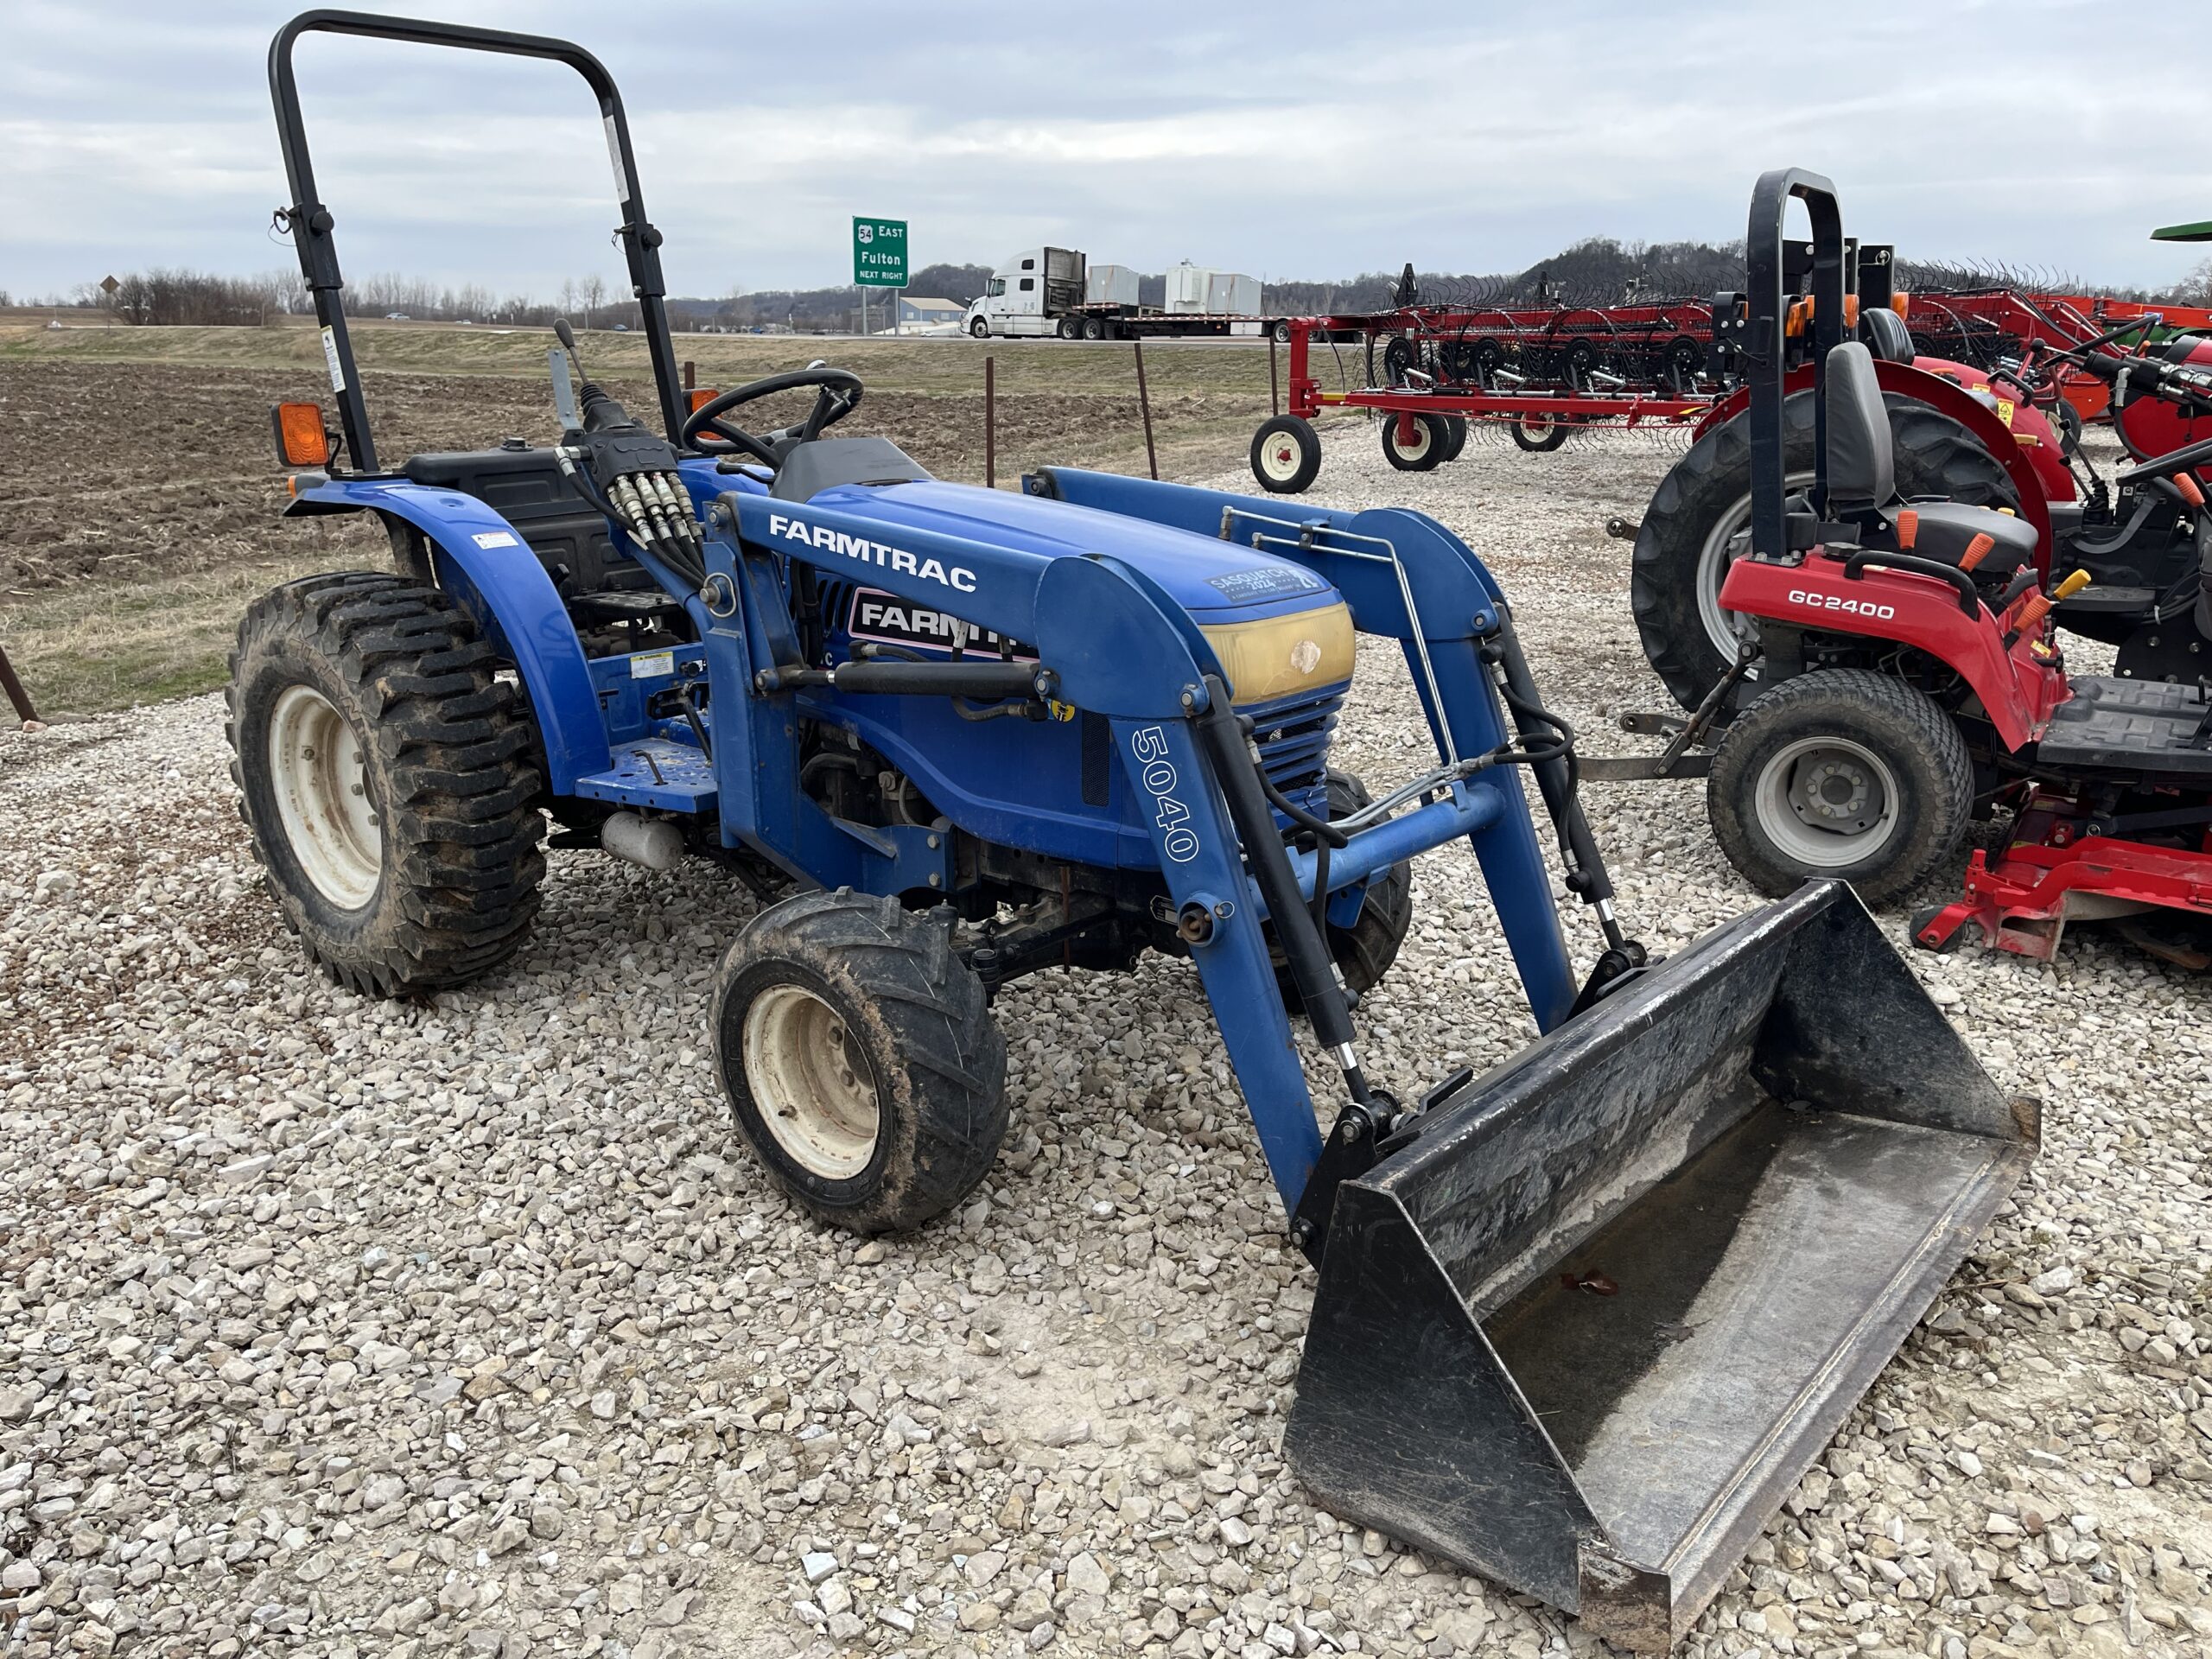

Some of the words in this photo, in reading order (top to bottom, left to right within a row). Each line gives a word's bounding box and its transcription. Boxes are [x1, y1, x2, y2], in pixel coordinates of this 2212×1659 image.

[860, 228, 872, 239] 54
[879, 226, 903, 238] EAST
[861, 251, 900, 265] Fulton
[882, 271, 903, 280] RIGHT
[770, 514, 976, 593] FARMTRAC
[1211, 569, 1289, 588] SASQUATCH
[1248, 580, 1276, 589] 2024
[1789, 590, 1895, 620] GC2400
[1132, 726, 1198, 862] 5040
